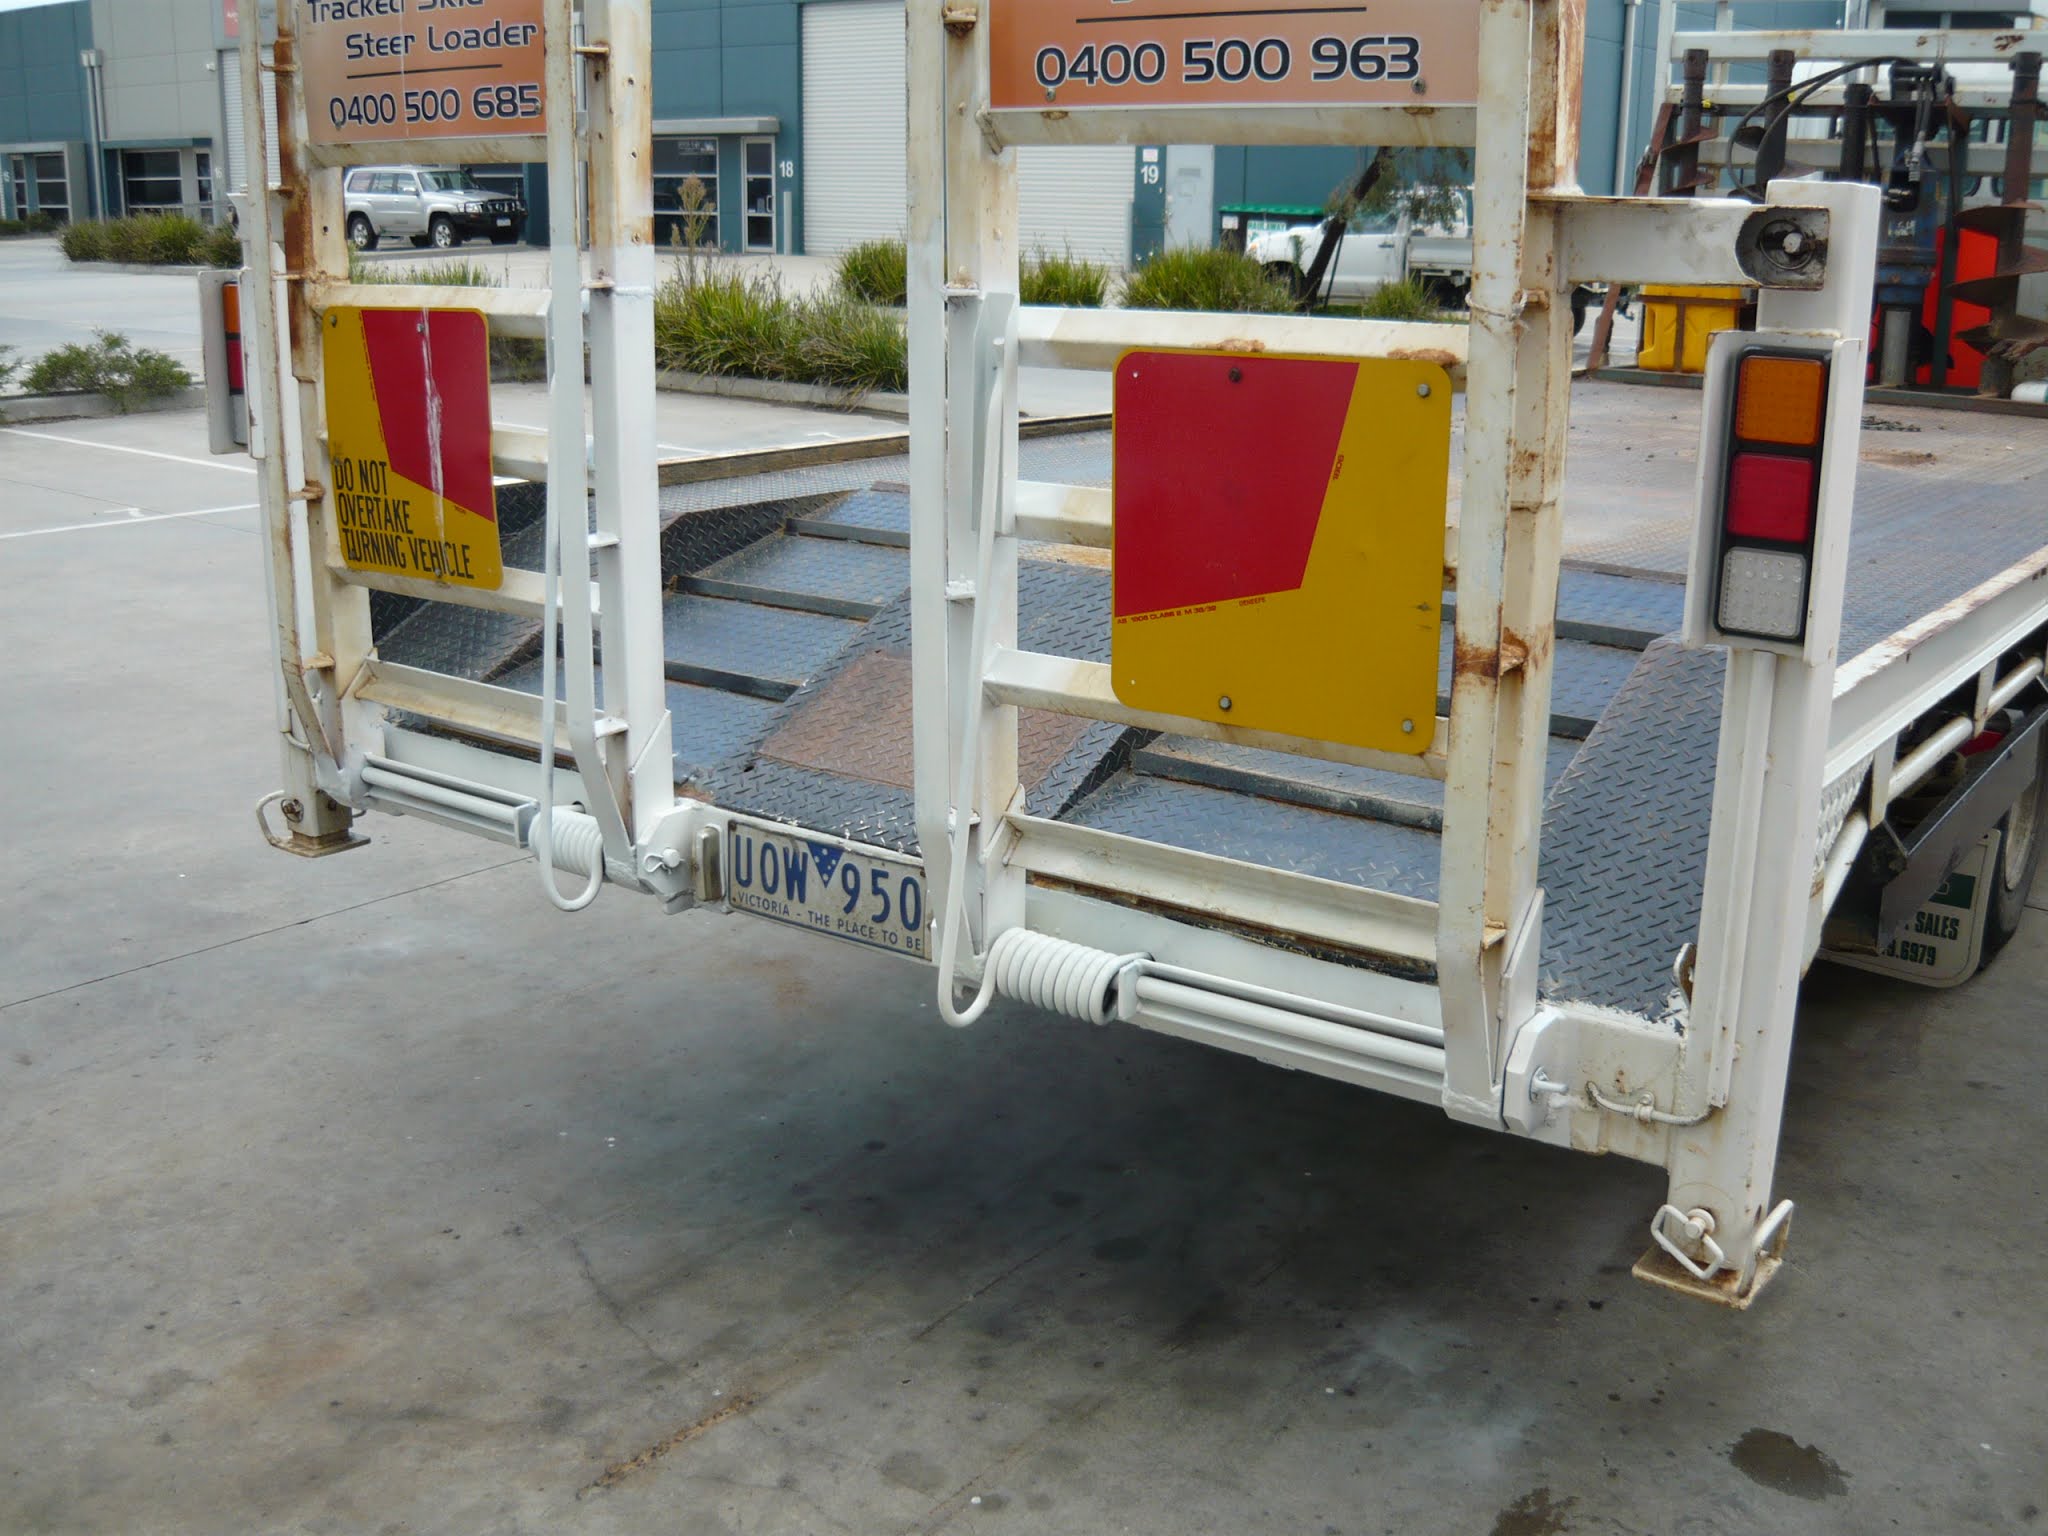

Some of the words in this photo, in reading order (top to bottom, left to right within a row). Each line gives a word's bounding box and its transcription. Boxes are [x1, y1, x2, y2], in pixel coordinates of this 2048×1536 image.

[346, 32, 416, 60] Steer
[427, 20, 537, 52] Loader
[1035, 41, 1166, 87] 0400
[1183, 37, 1291, 83] 500
[1311, 35, 1422, 82] 963
[330, 92, 396, 128] 0400
[404, 88, 460, 123] 500
[473, 84, 541, 119] 685
[779, 161, 794, 178] 18
[1141, 165, 1159, 184] 19
[334, 457, 354, 492] DO
[358, 459, 388, 495] NOT
[338, 493, 414, 534] OVERTAKE
[342, 528, 407, 569] TURNING
[407, 537, 475, 579] VEHICLE
[735, 834, 809, 904] UOW
[841, 862, 922, 932] 950
[737, 891, 791, 917] VICTORIA
[808, 910, 830, 927] THE
[837, 919, 875, 940] PLACE
[881, 930, 898, 945] TO
[906, 936, 921, 951] BE
[1915, 911, 1959, 940] SALES
